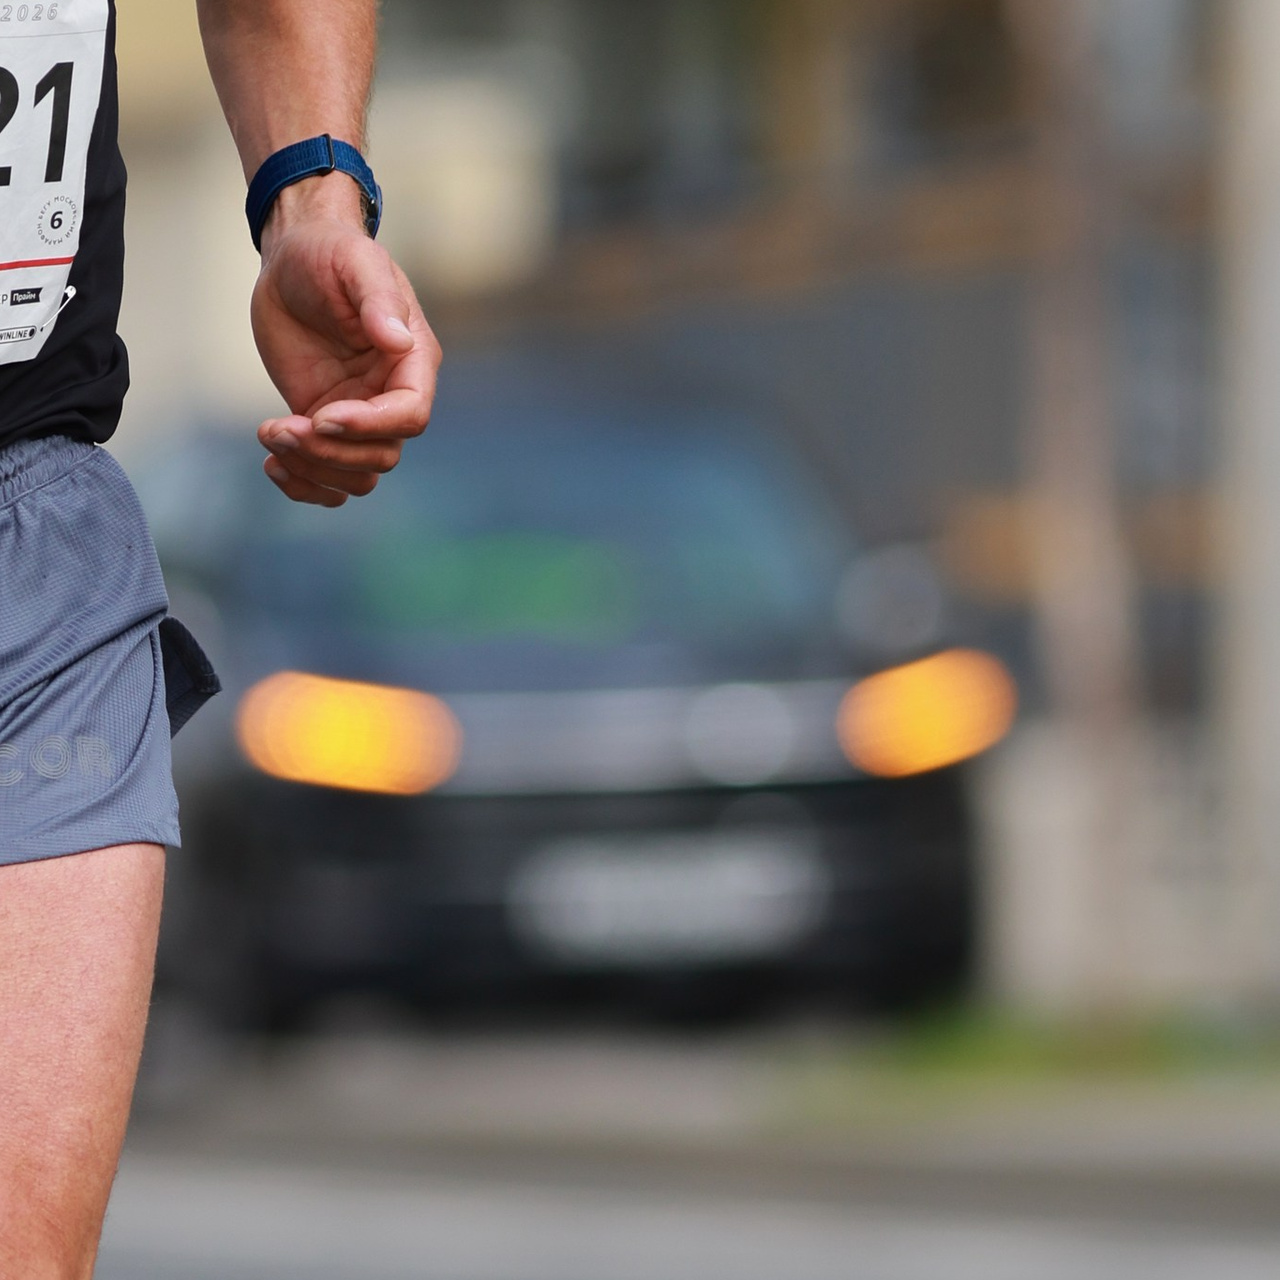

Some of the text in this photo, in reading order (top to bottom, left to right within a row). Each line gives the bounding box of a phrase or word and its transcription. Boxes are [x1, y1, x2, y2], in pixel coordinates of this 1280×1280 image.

[0, 3, 59, 22] 2026
[49, 210, 63, 230] 6
[13, 291, 36, 303] Прайм
